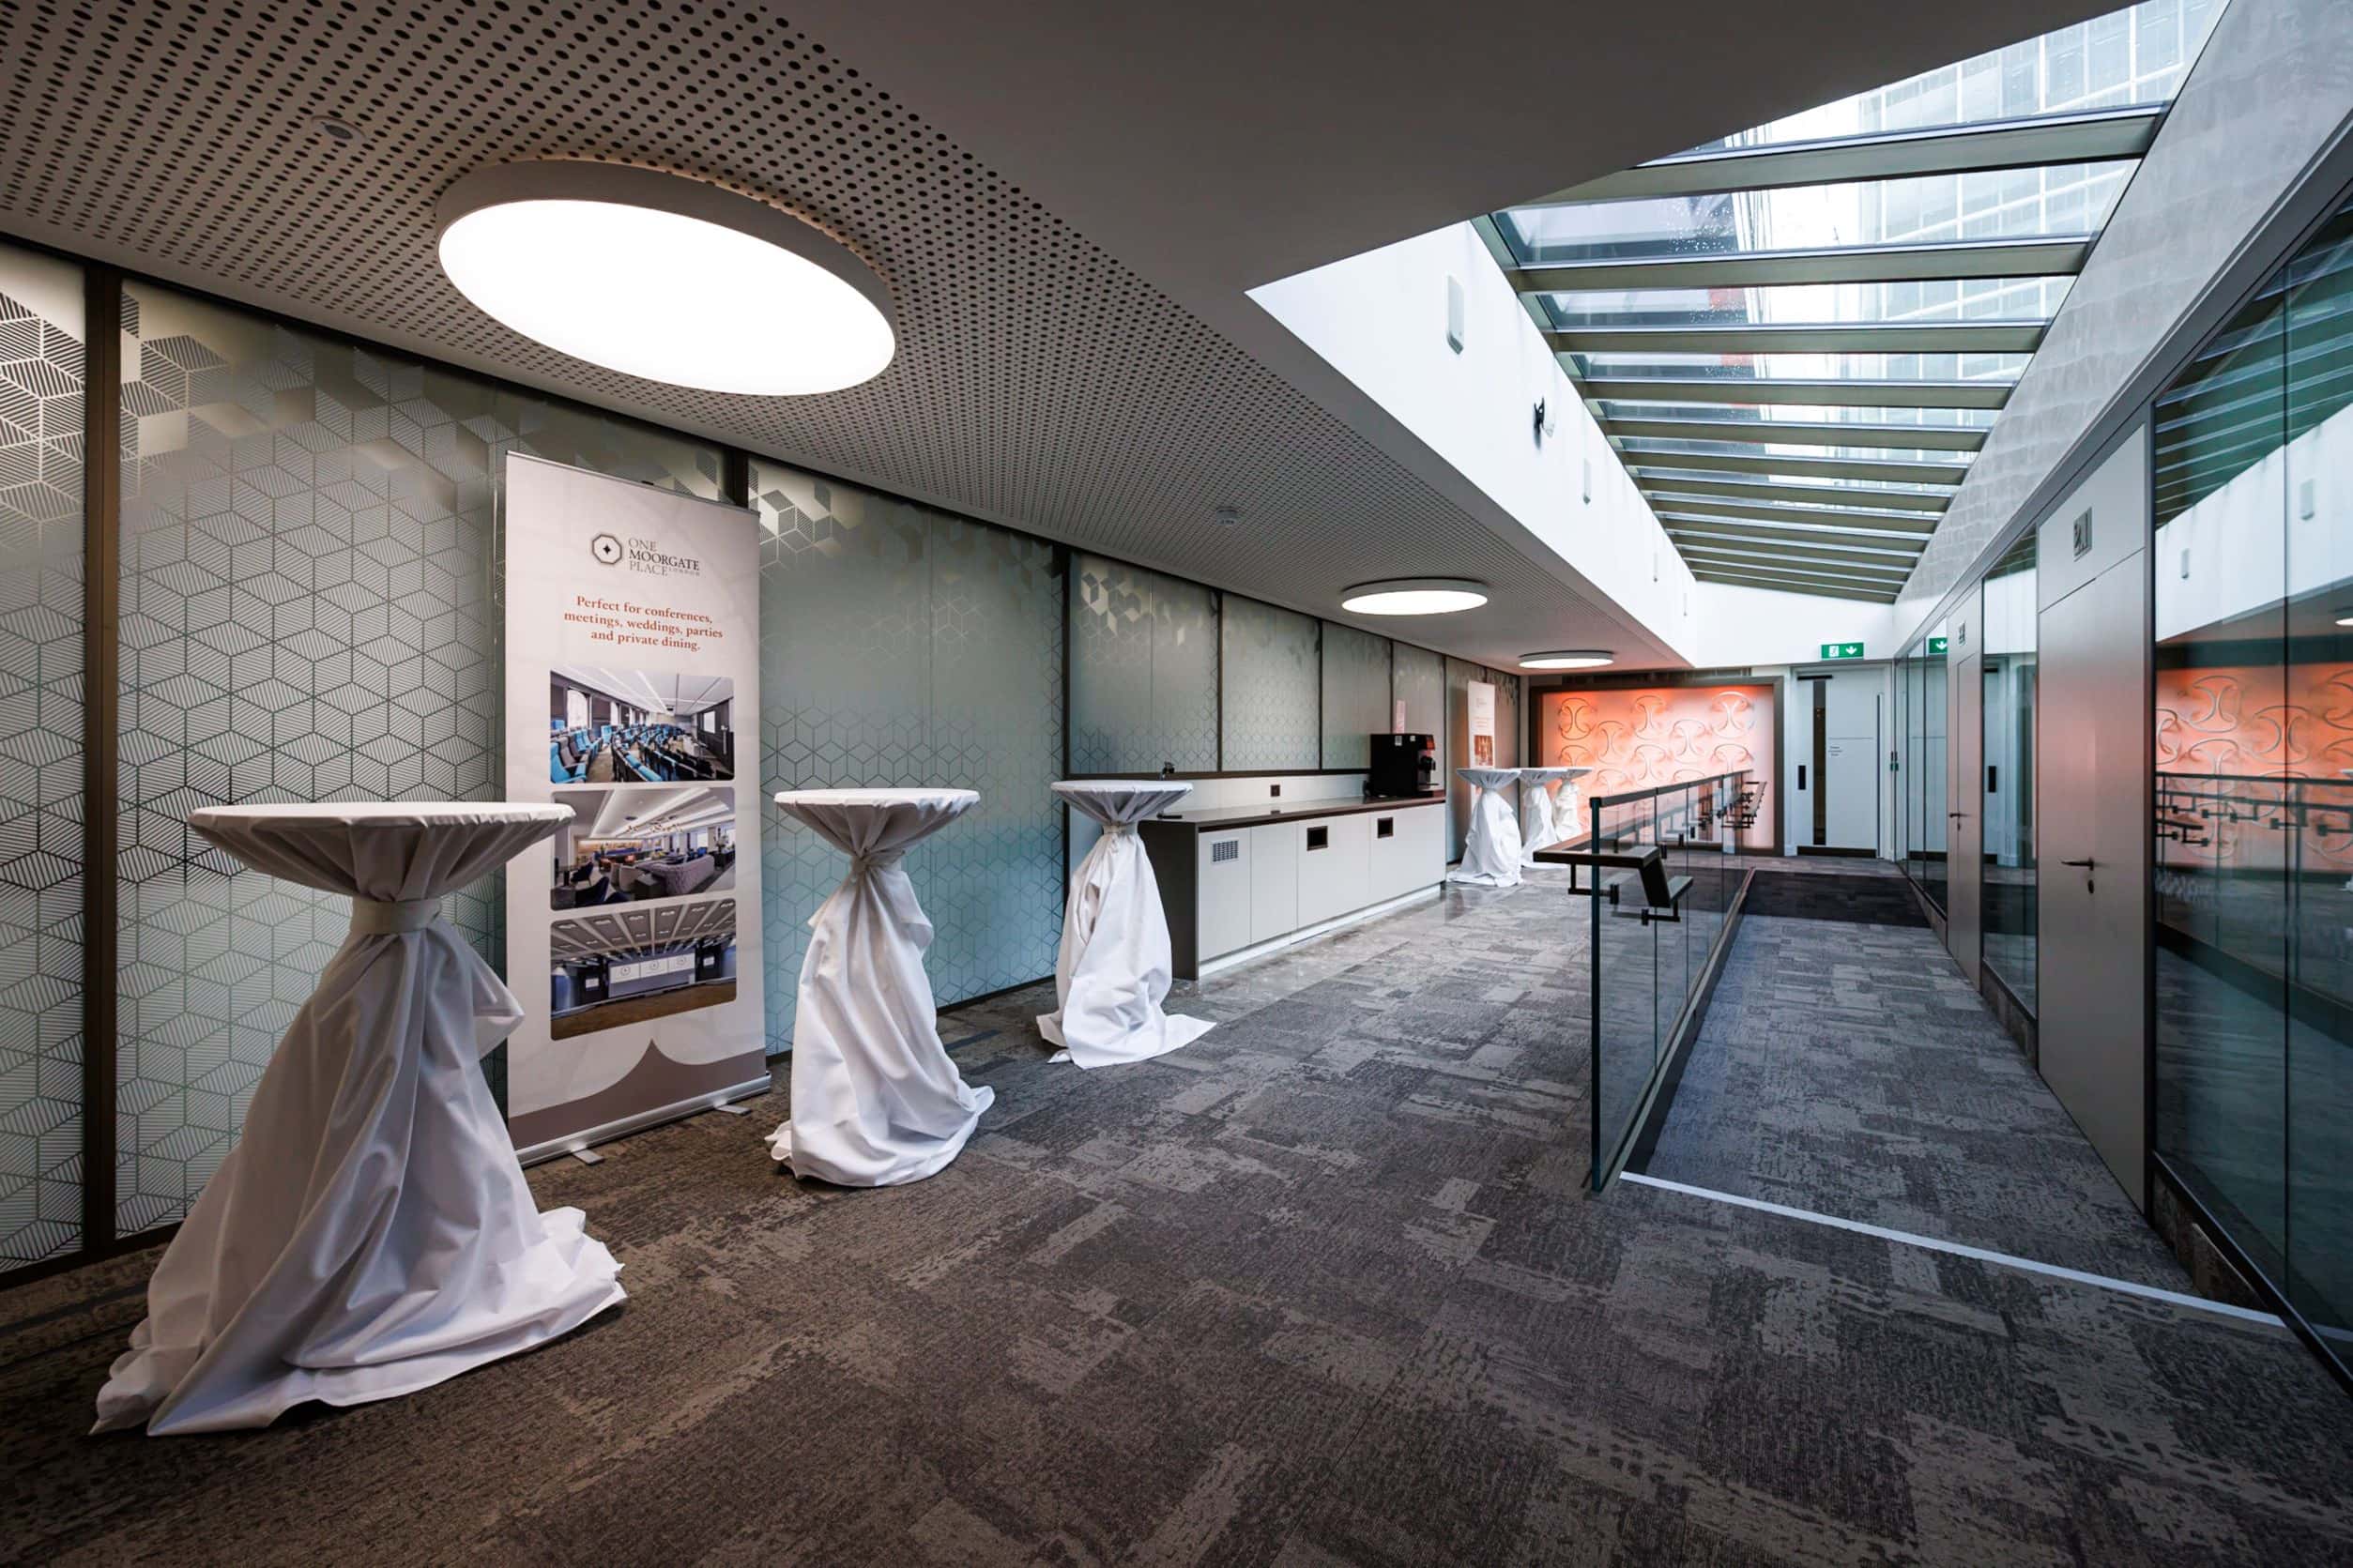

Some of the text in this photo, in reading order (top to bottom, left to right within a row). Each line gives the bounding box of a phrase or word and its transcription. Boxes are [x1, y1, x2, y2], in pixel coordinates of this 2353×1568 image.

[628, 539, 657, 552] ONE
[629, 549, 699, 571] MOORGATE
[629, 560, 668, 576] PLACE
[576, 596, 712, 624] Perfect for conferences,
[564, 612, 724, 639] meetings, weddings, parties
[590, 630, 701, 651] and private dining.
